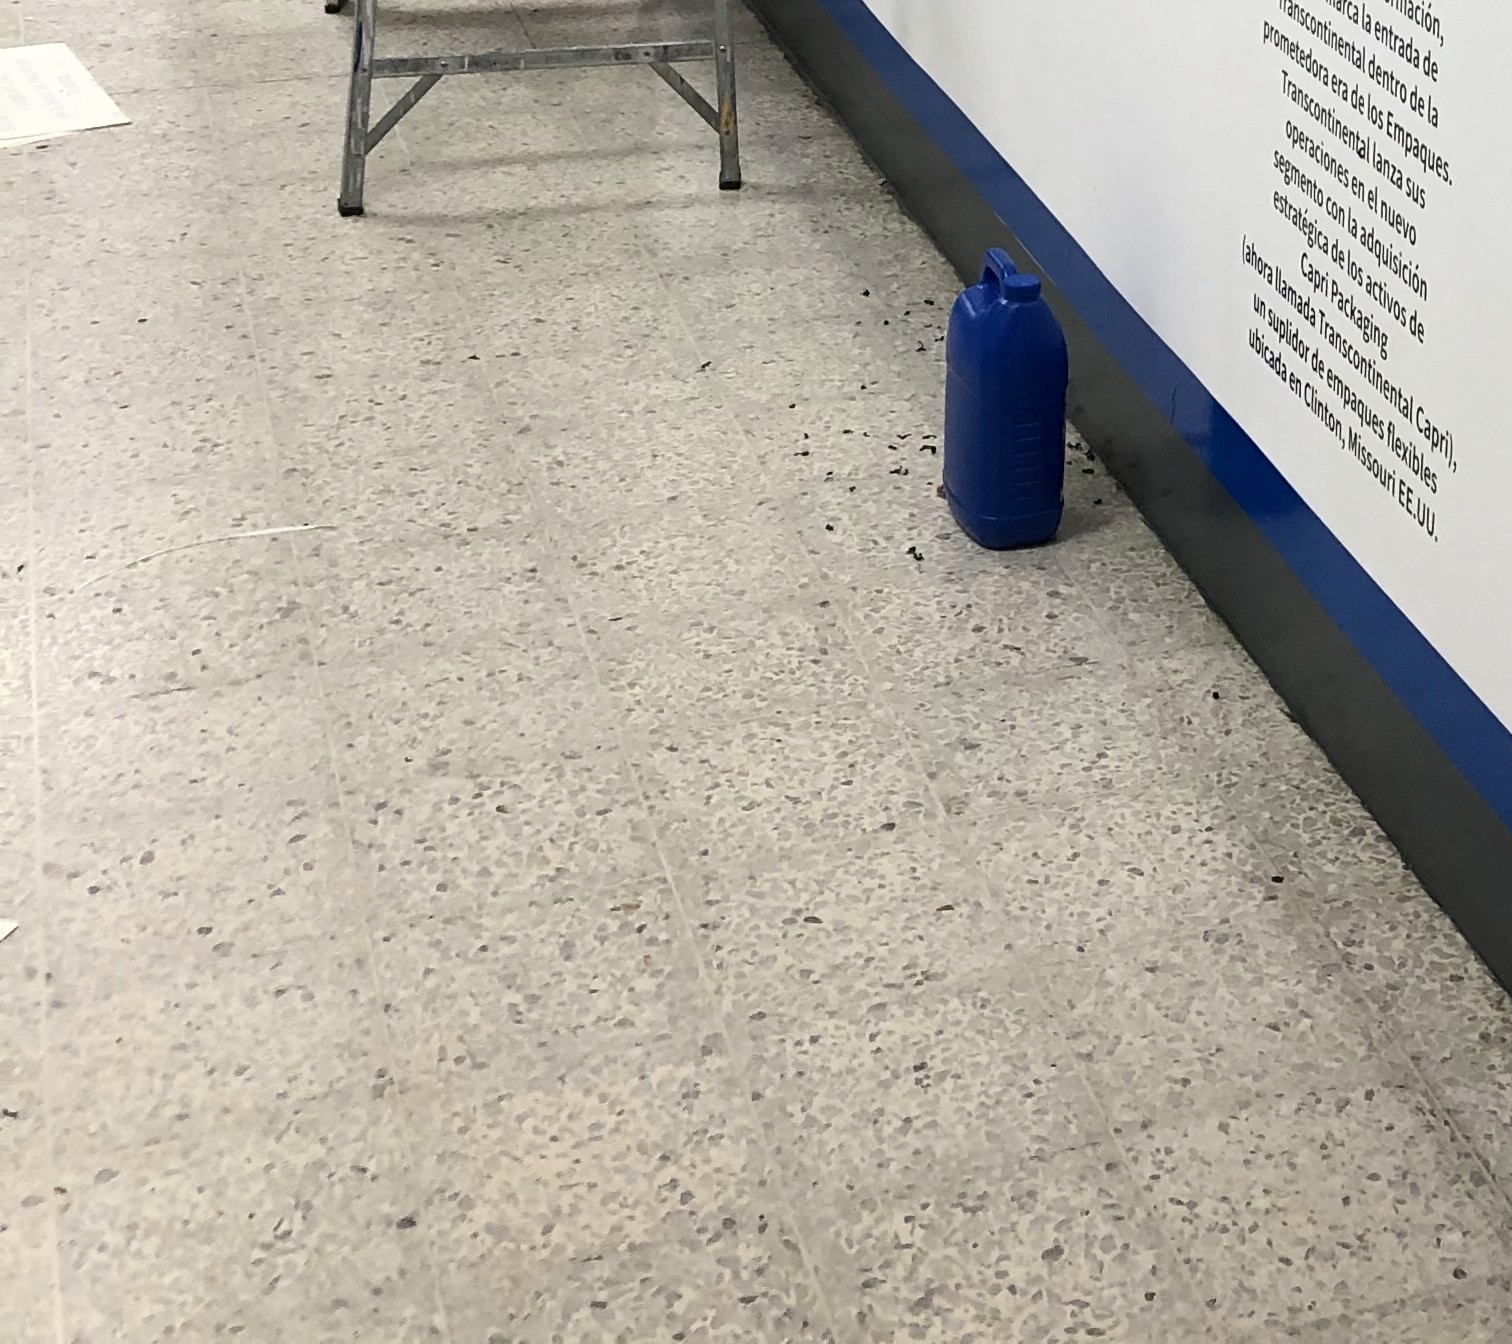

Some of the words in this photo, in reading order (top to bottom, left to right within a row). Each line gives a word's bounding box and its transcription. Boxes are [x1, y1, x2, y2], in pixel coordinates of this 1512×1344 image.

[1263, 20, 1329, 87] prometedora
[1331, 74, 1348, 102] era
[1351, 84, 1364, 115] de
[1367, 93, 1383, 130] los
[1386, 111, 1452, 186] Empaques.
[1368, 54, 1407, 104] dentro
[1410, 85, 1425, 118] de
[1428, 95, 1438, 128] la
[1301, 252, 1329, 297] Capri
[1331, 279, 1388, 361] Packaging
